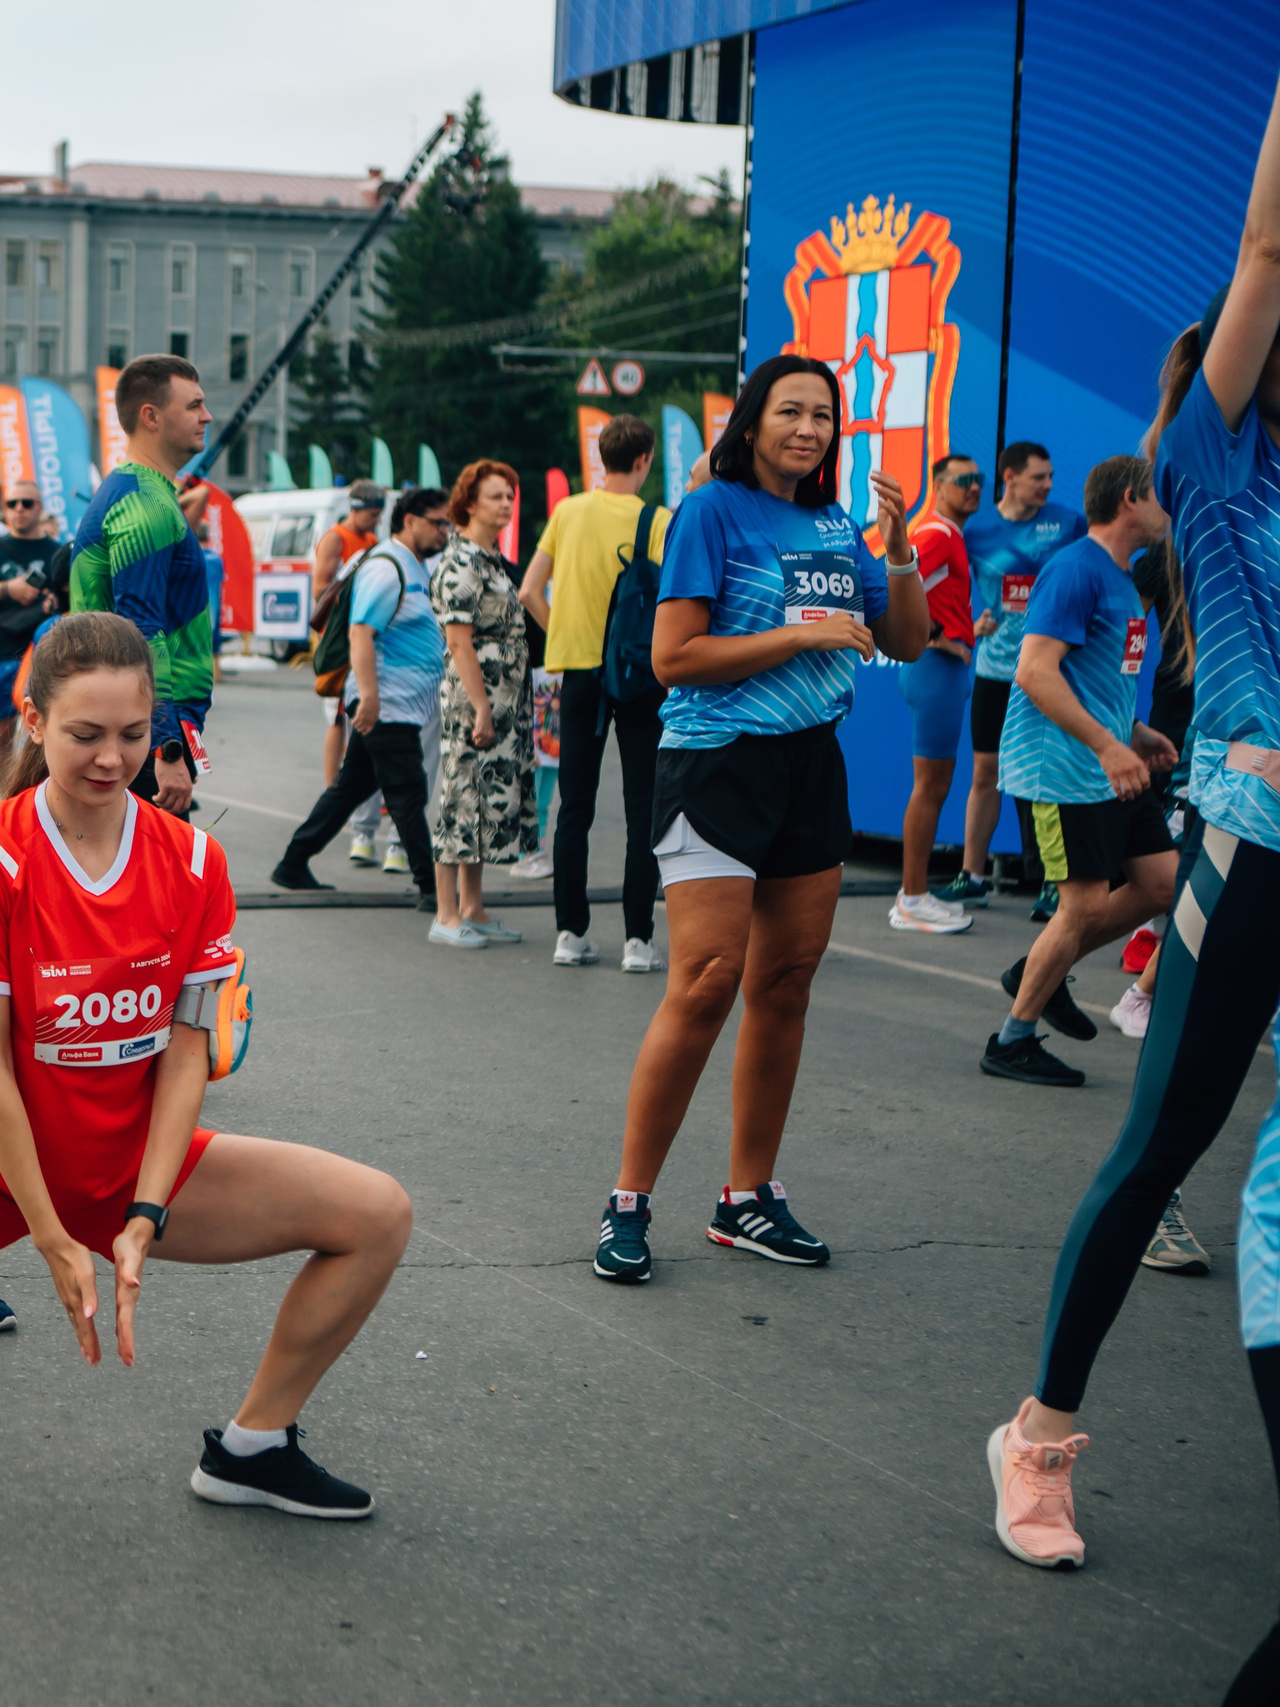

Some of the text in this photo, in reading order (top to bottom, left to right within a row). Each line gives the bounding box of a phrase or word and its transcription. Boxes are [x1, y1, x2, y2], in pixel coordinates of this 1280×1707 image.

[794, 571, 855, 598] 3069
[54, 984, 162, 1028] 2080
[61, 1051, 83, 1059] Альфа
[126, 1042, 154, 1055] Следопыт
